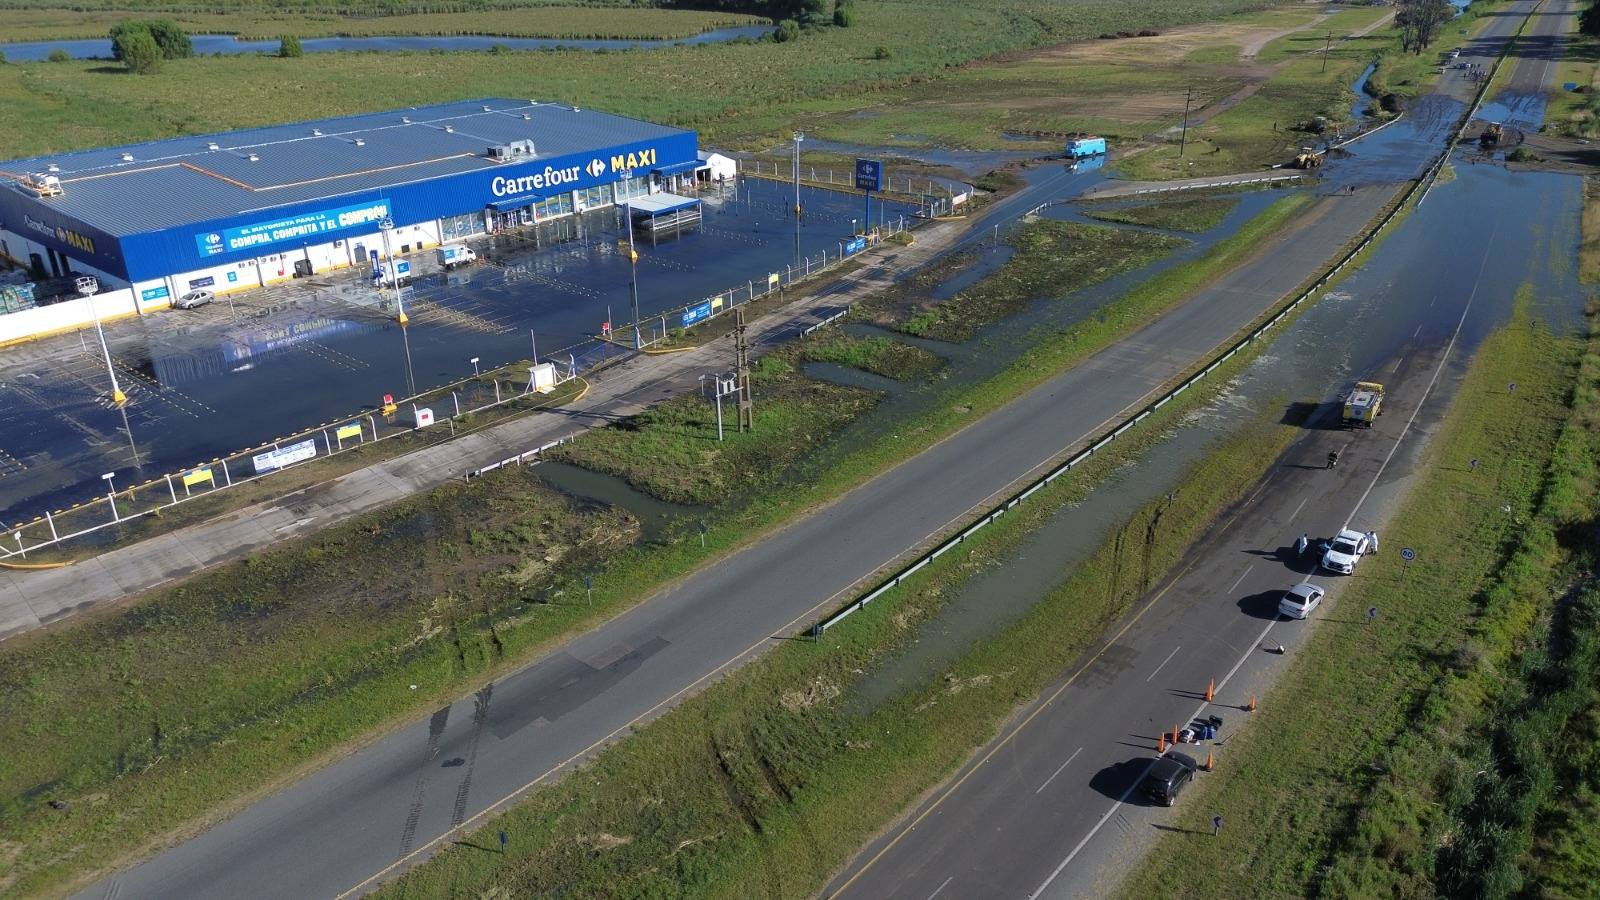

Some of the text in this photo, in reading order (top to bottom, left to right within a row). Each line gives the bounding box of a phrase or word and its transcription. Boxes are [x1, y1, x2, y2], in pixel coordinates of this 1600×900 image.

[491, 148, 656, 197] Carrefour MAXI
[230, 232, 273, 249] COMPRA,
[272, 222, 319, 240] COMPRITA
[319, 221, 326, 231] Y
[326, 219, 338, 230] EL
[251, 219, 295, 233] MAYORISTA
[65, 229, 95, 254] MAXI
